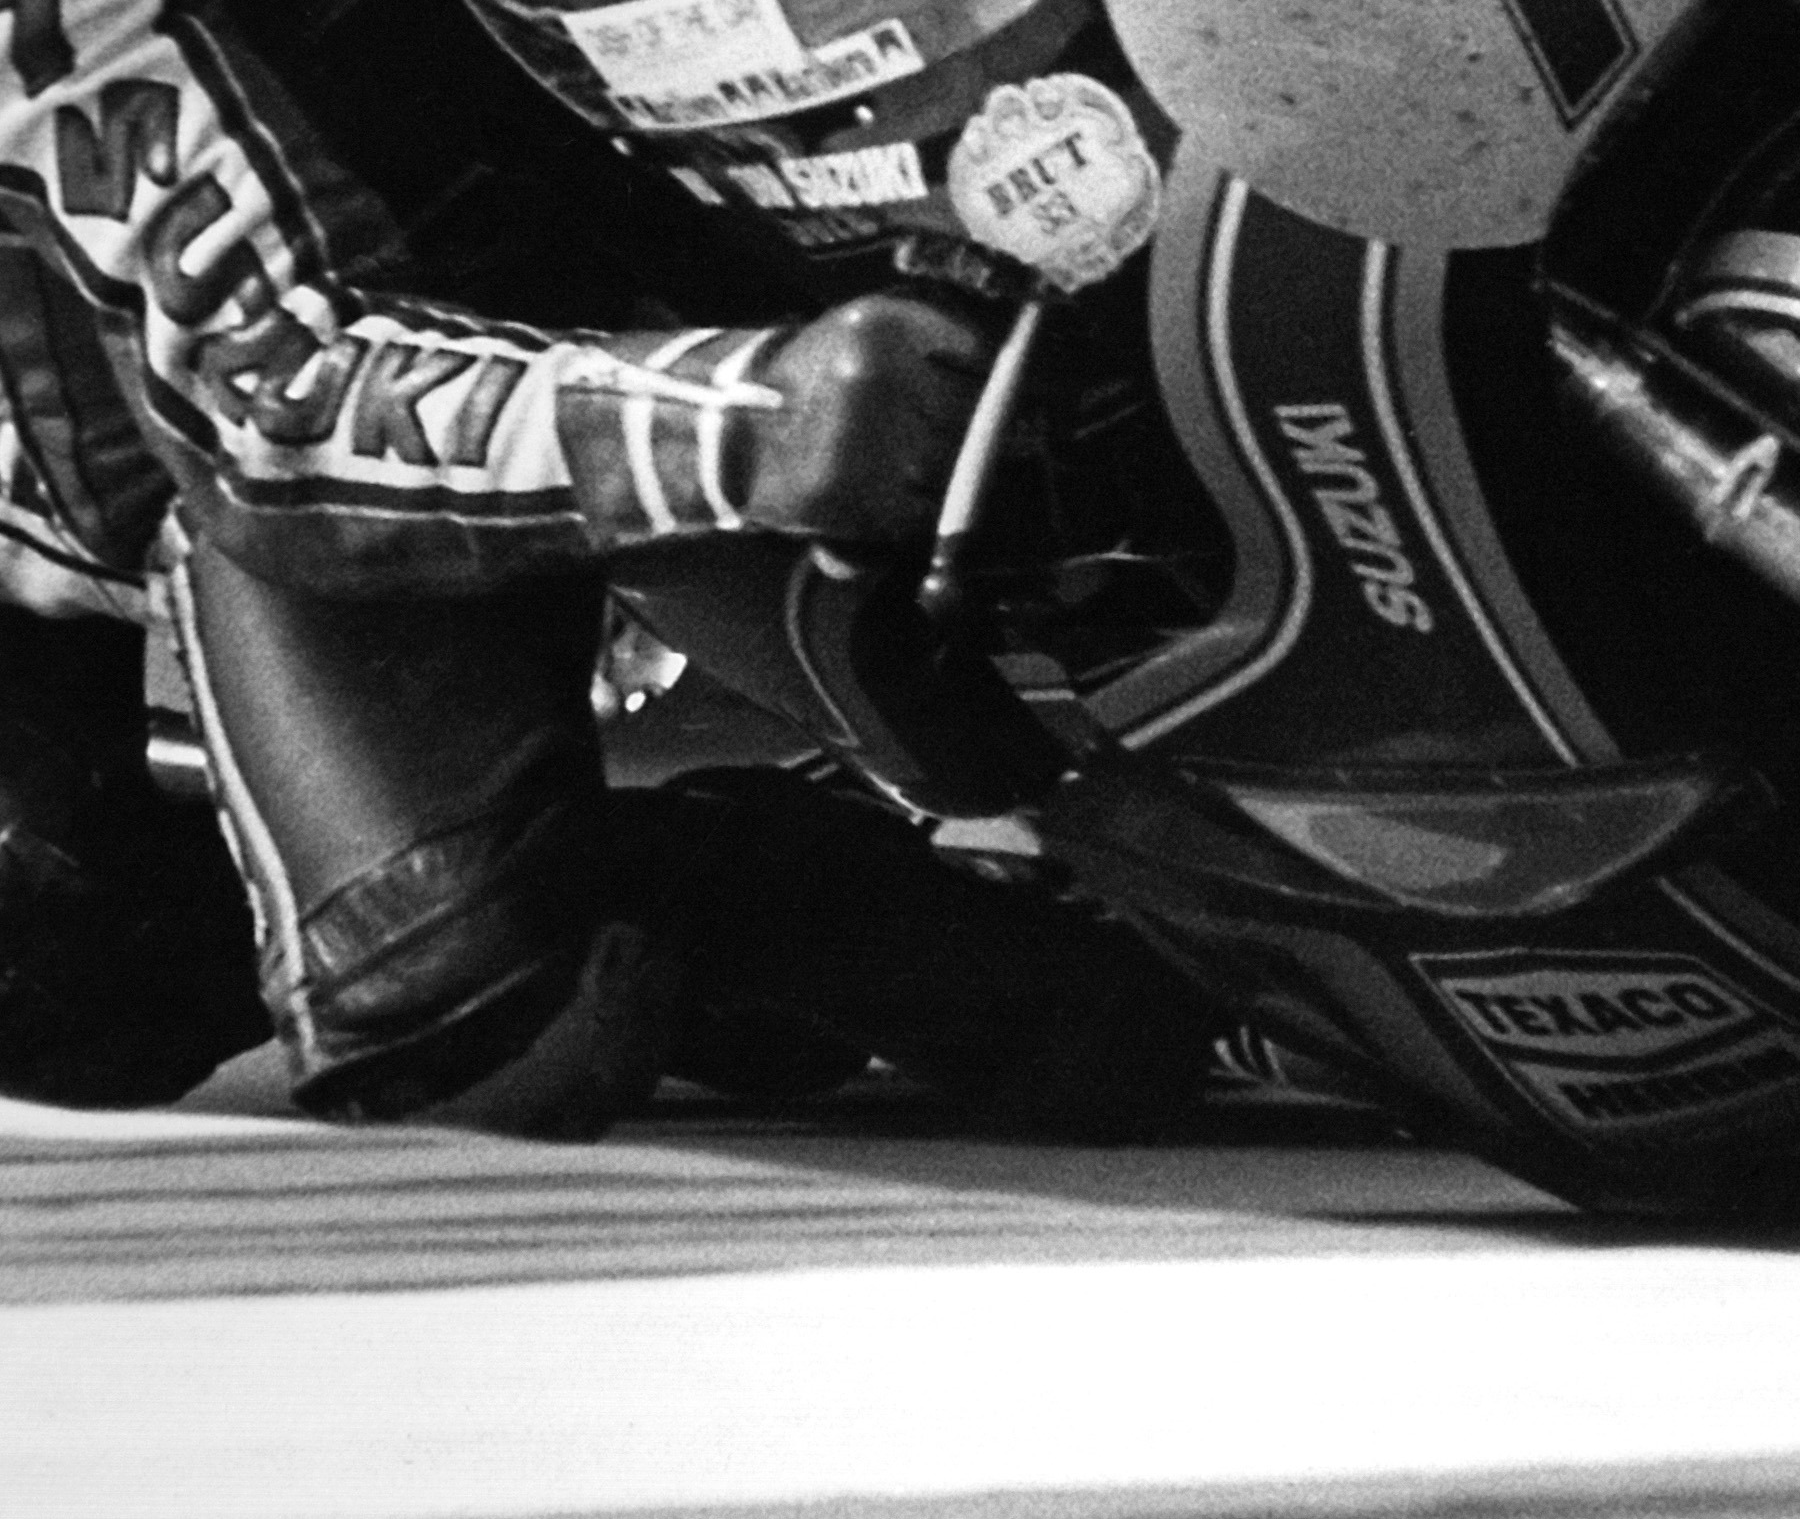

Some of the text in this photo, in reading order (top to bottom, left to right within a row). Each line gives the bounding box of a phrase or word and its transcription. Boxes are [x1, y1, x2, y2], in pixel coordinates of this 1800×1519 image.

[986, 131, 1092, 218] BRUT
[50, 80, 526, 471] SUZUKI
[1275, 403, 1433, 634] SUZUKI
[1462, 981, 1726, 1041] TEXACO
